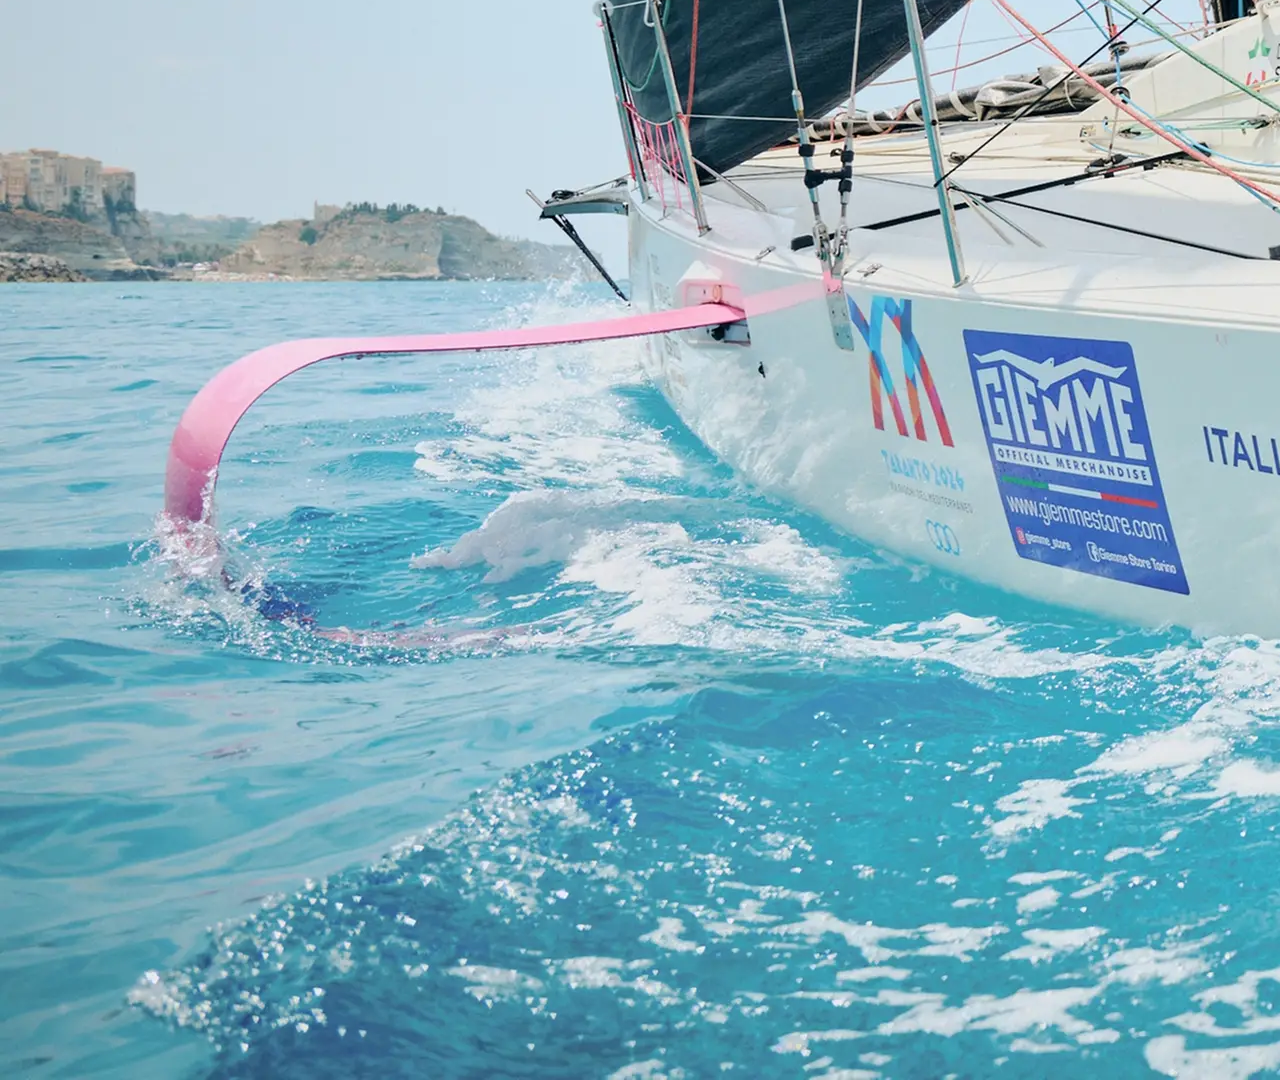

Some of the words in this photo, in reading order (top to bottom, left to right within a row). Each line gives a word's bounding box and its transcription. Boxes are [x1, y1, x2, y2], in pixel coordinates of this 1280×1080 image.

[976, 365, 1147, 461] GIEMME
[998, 447, 1050, 466] OFFICIAL
[1056, 458, 1148, 481] MERCHANDISE
[1006, 496, 1168, 542] www.giemmestore.com
